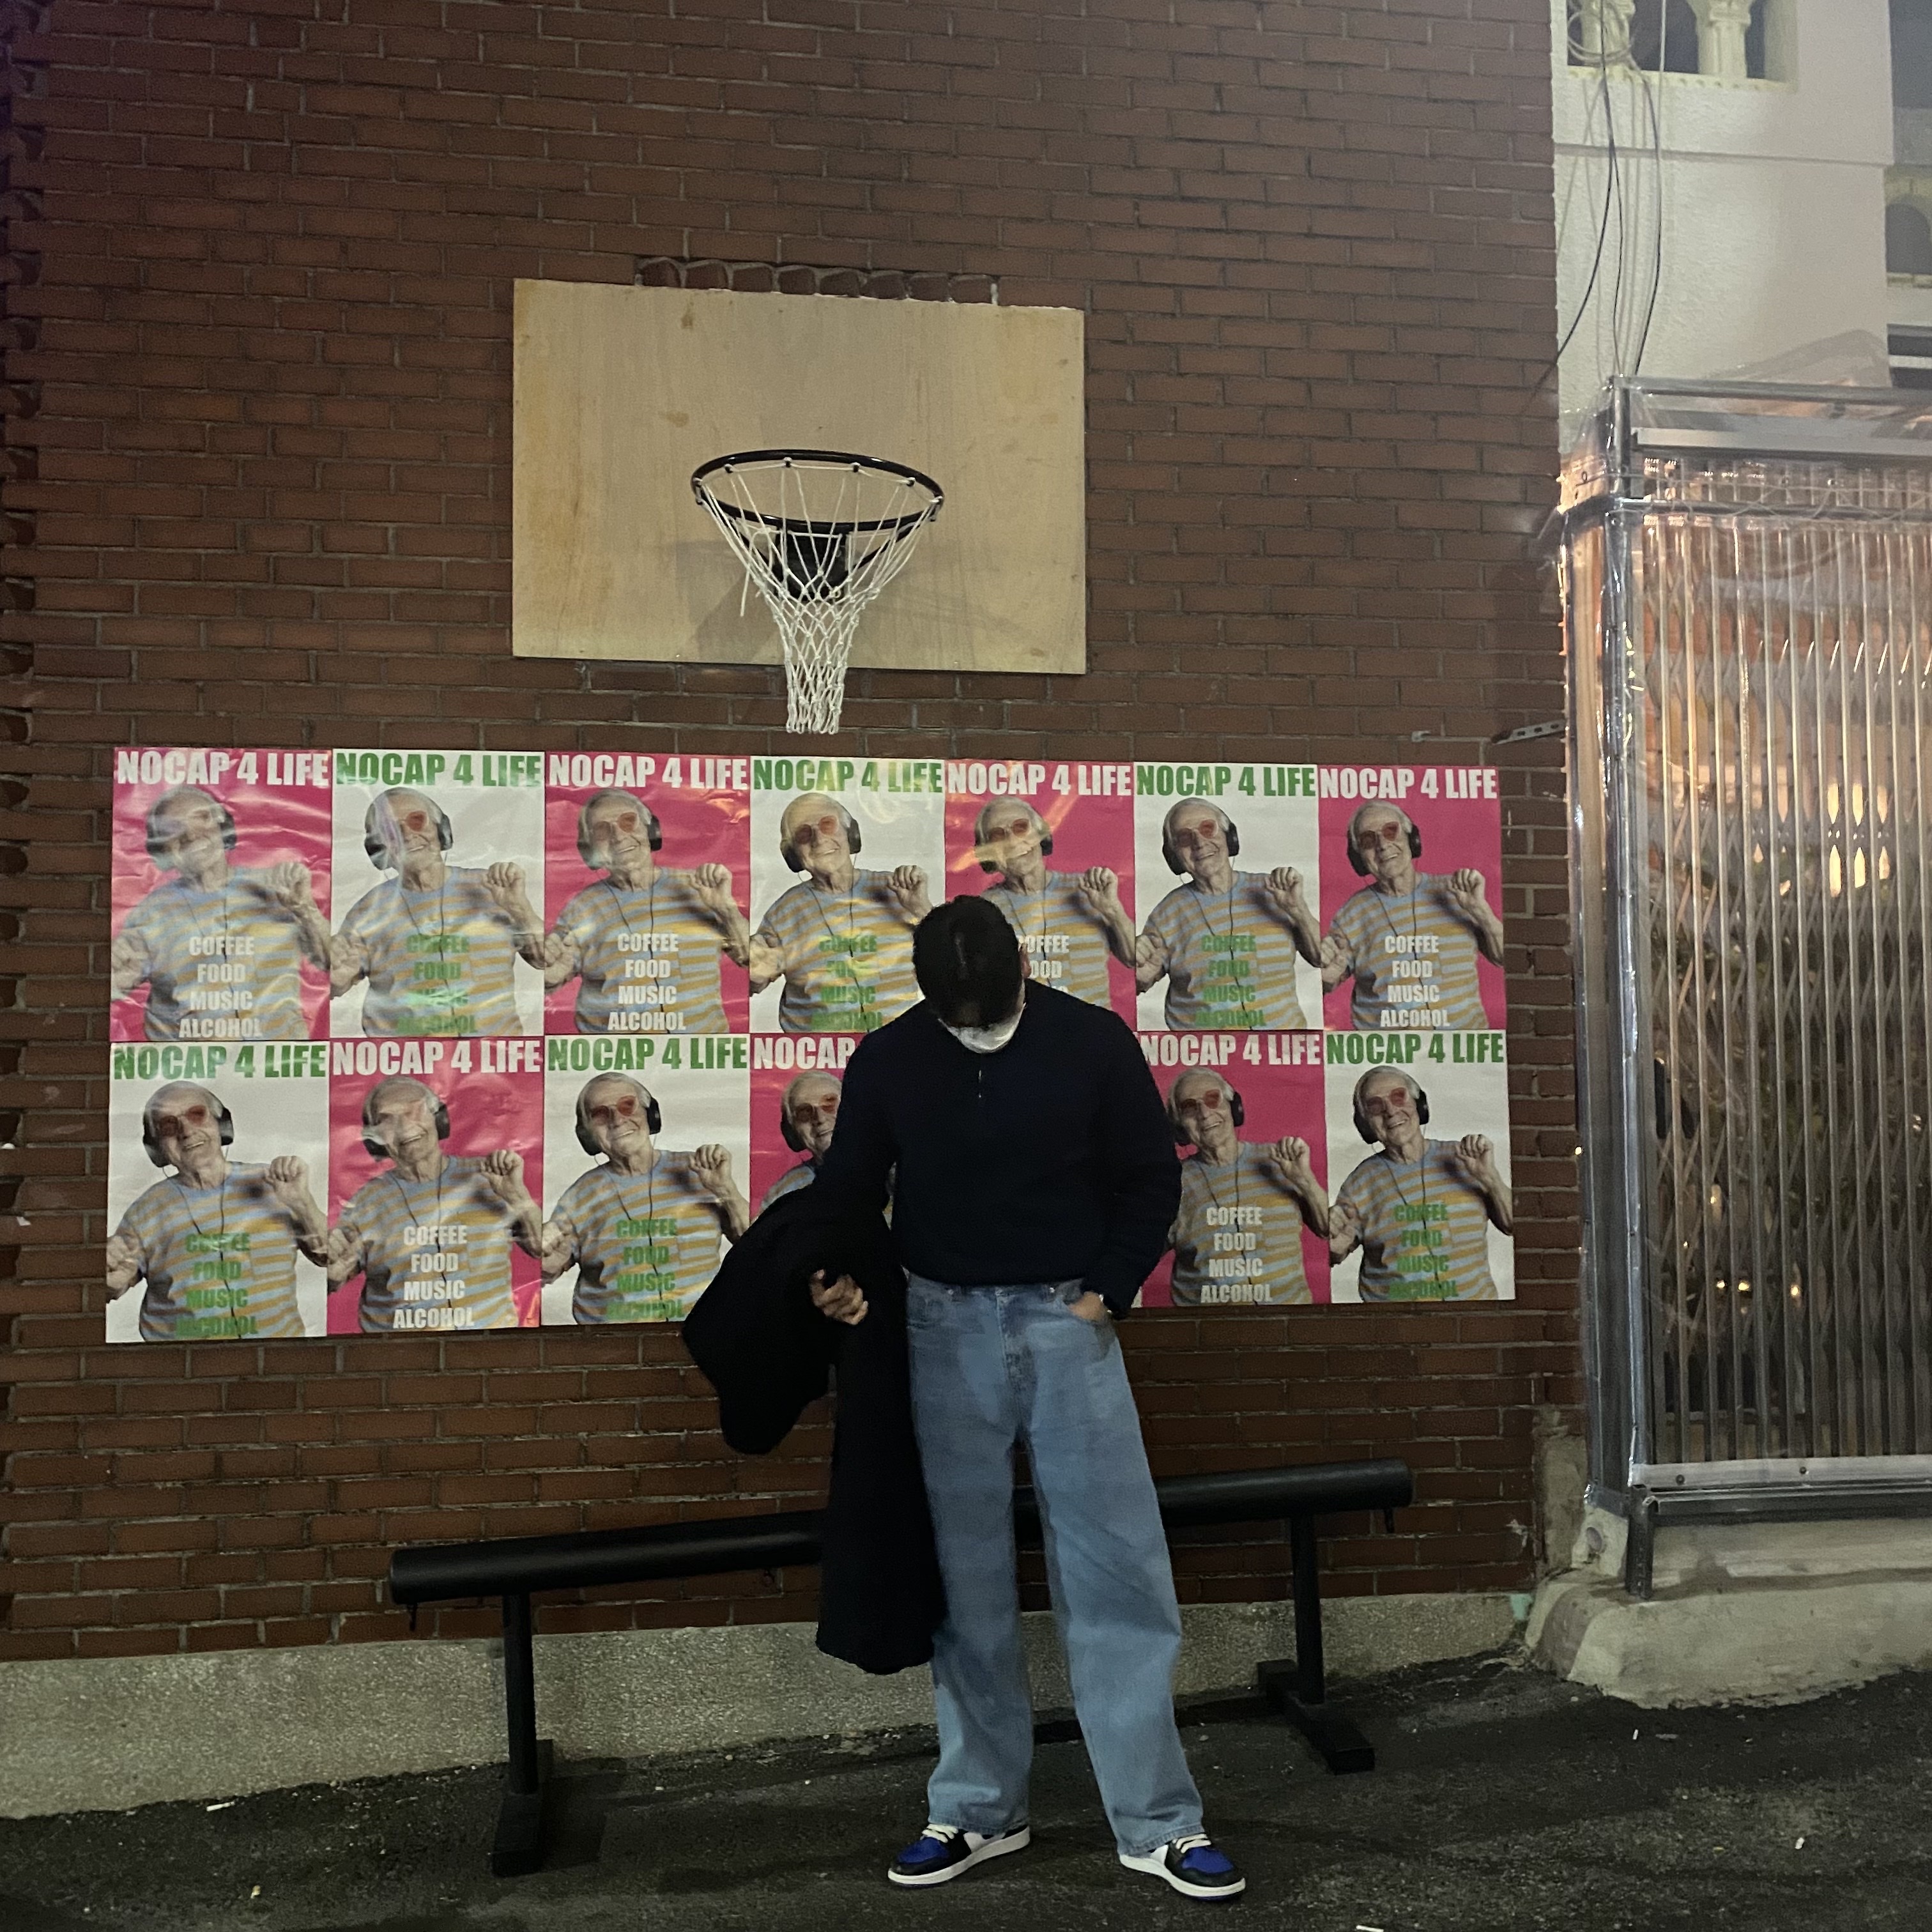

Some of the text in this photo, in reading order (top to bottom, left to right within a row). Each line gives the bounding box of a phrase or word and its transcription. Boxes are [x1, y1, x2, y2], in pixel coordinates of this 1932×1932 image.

[118, 752, 329, 786] NOCAP 4 LIFE
[336, 753, 540, 786] NOCAP 4 LIFE
[549, 755, 747, 790] NOCAP 4 LIFE
[754, 760, 942, 793] NOCAP 4 LIFE
[948, 763, 1131, 795] NOCAP 4 LIFE
[1137, 765, 1315, 797] NOCAP 4 LIFE
[1321, 768, 1497, 799] NOCAP 4 LIFE
[190, 937, 254, 956] COFFEE
[617, 933, 678, 952] COFFEE
[1384, 935, 1439, 953] COFFEE
[197, 963, 245, 983] FOOD
[625, 959, 670, 978] FOOD
[1028, 960, 1062, 978] OOD
[1208, 960, 1250, 977] FOOD
[1392, 960, 1432, 977] FOOD
[191, 990, 252, 1010] MUSIC
[618, 986, 677, 1004] MUSIC
[1202, 985, 1256, 1003] MUSIC
[1387, 985, 1439, 1002] MUSIC
[179, 1018, 262, 1038] ALCOHOL
[608, 1011, 686, 1031] ALCOHOL
[1381, 1009, 1450, 1027] ALCOHOL
[333, 1041, 540, 1074] NOCAP 4 LIFE
[548, 1038, 747, 1071] NOCAP 4 LIFE
[754, 1037, 855, 1069] NOCAP
[1141, 1034, 1321, 1066] NOCAP 4 LIFE
[1327, 1033, 1504, 1064] NOCAP 4 LIFE
[114, 1045, 325, 1079] NOCAP 4 LIFE
[1206, 1208, 1262, 1226] COFFEE
[403, 1225, 467, 1245] COFFEE
[616, 1218, 677, 1238] COFFEE
[1400, 1229, 1443, 1247] FOOD
[1214, 1232, 1256, 1252] FOOD
[411, 1253, 458, 1272] FOOD
[623, 1246, 670, 1265] FOOD
[1396, 1255, 1450, 1273] MUSIC
[193, 1261, 241, 1280] FOOD
[1209, 1259, 1262, 1277] MUSIC
[404, 1280, 464, 1300] MUSIC
[617, 1273, 675, 1292] MUSIC
[185, 1288, 249, 1308] MUSIC
[1201, 1284, 1273, 1303] ALCOHOL
[393, 1307, 474, 1328] ALCOHOL
